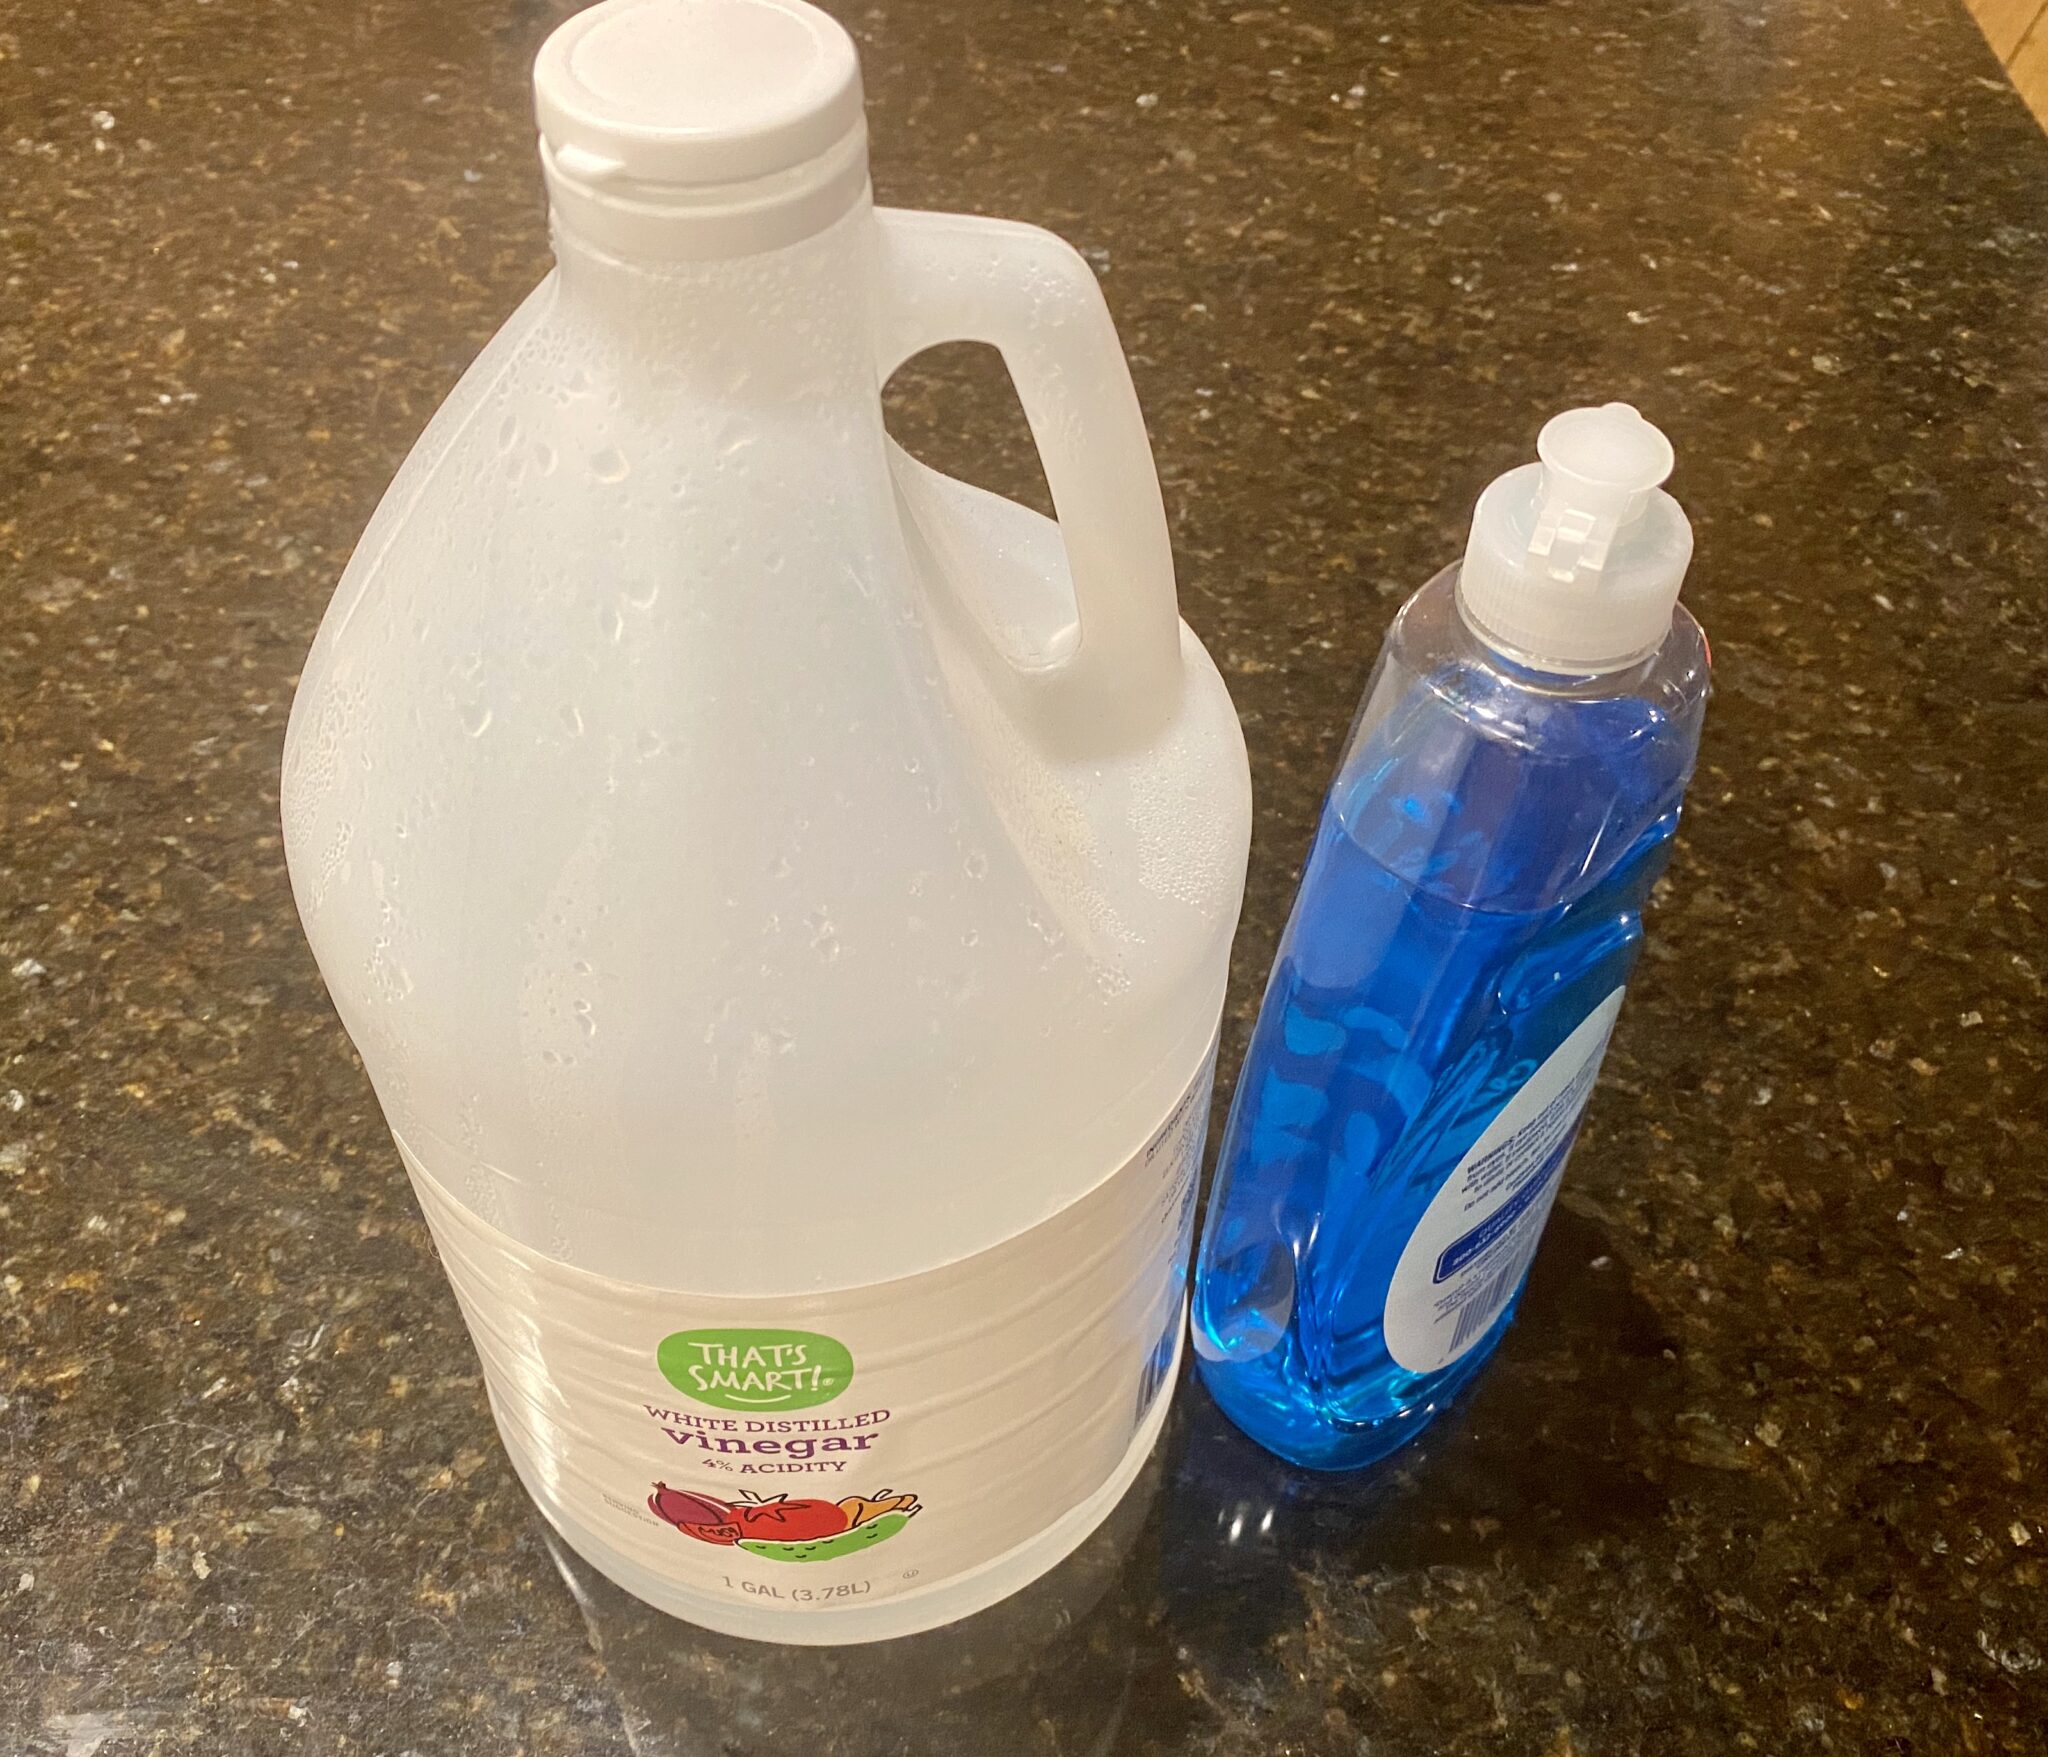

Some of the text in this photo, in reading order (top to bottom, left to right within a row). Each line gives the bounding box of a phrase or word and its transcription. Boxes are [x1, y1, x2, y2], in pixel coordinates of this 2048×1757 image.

[688, 1342, 808, 1369] THAT'S
[688, 1364, 823, 1392] SMART!
[643, 1404, 891, 1433] WHITE DISTILLED
[661, 1426, 880, 1459] vinegar
[701, 1458, 848, 1474] 4% ACIDITY
[722, 1575, 872, 1602] 1 GAL (3.78L)
